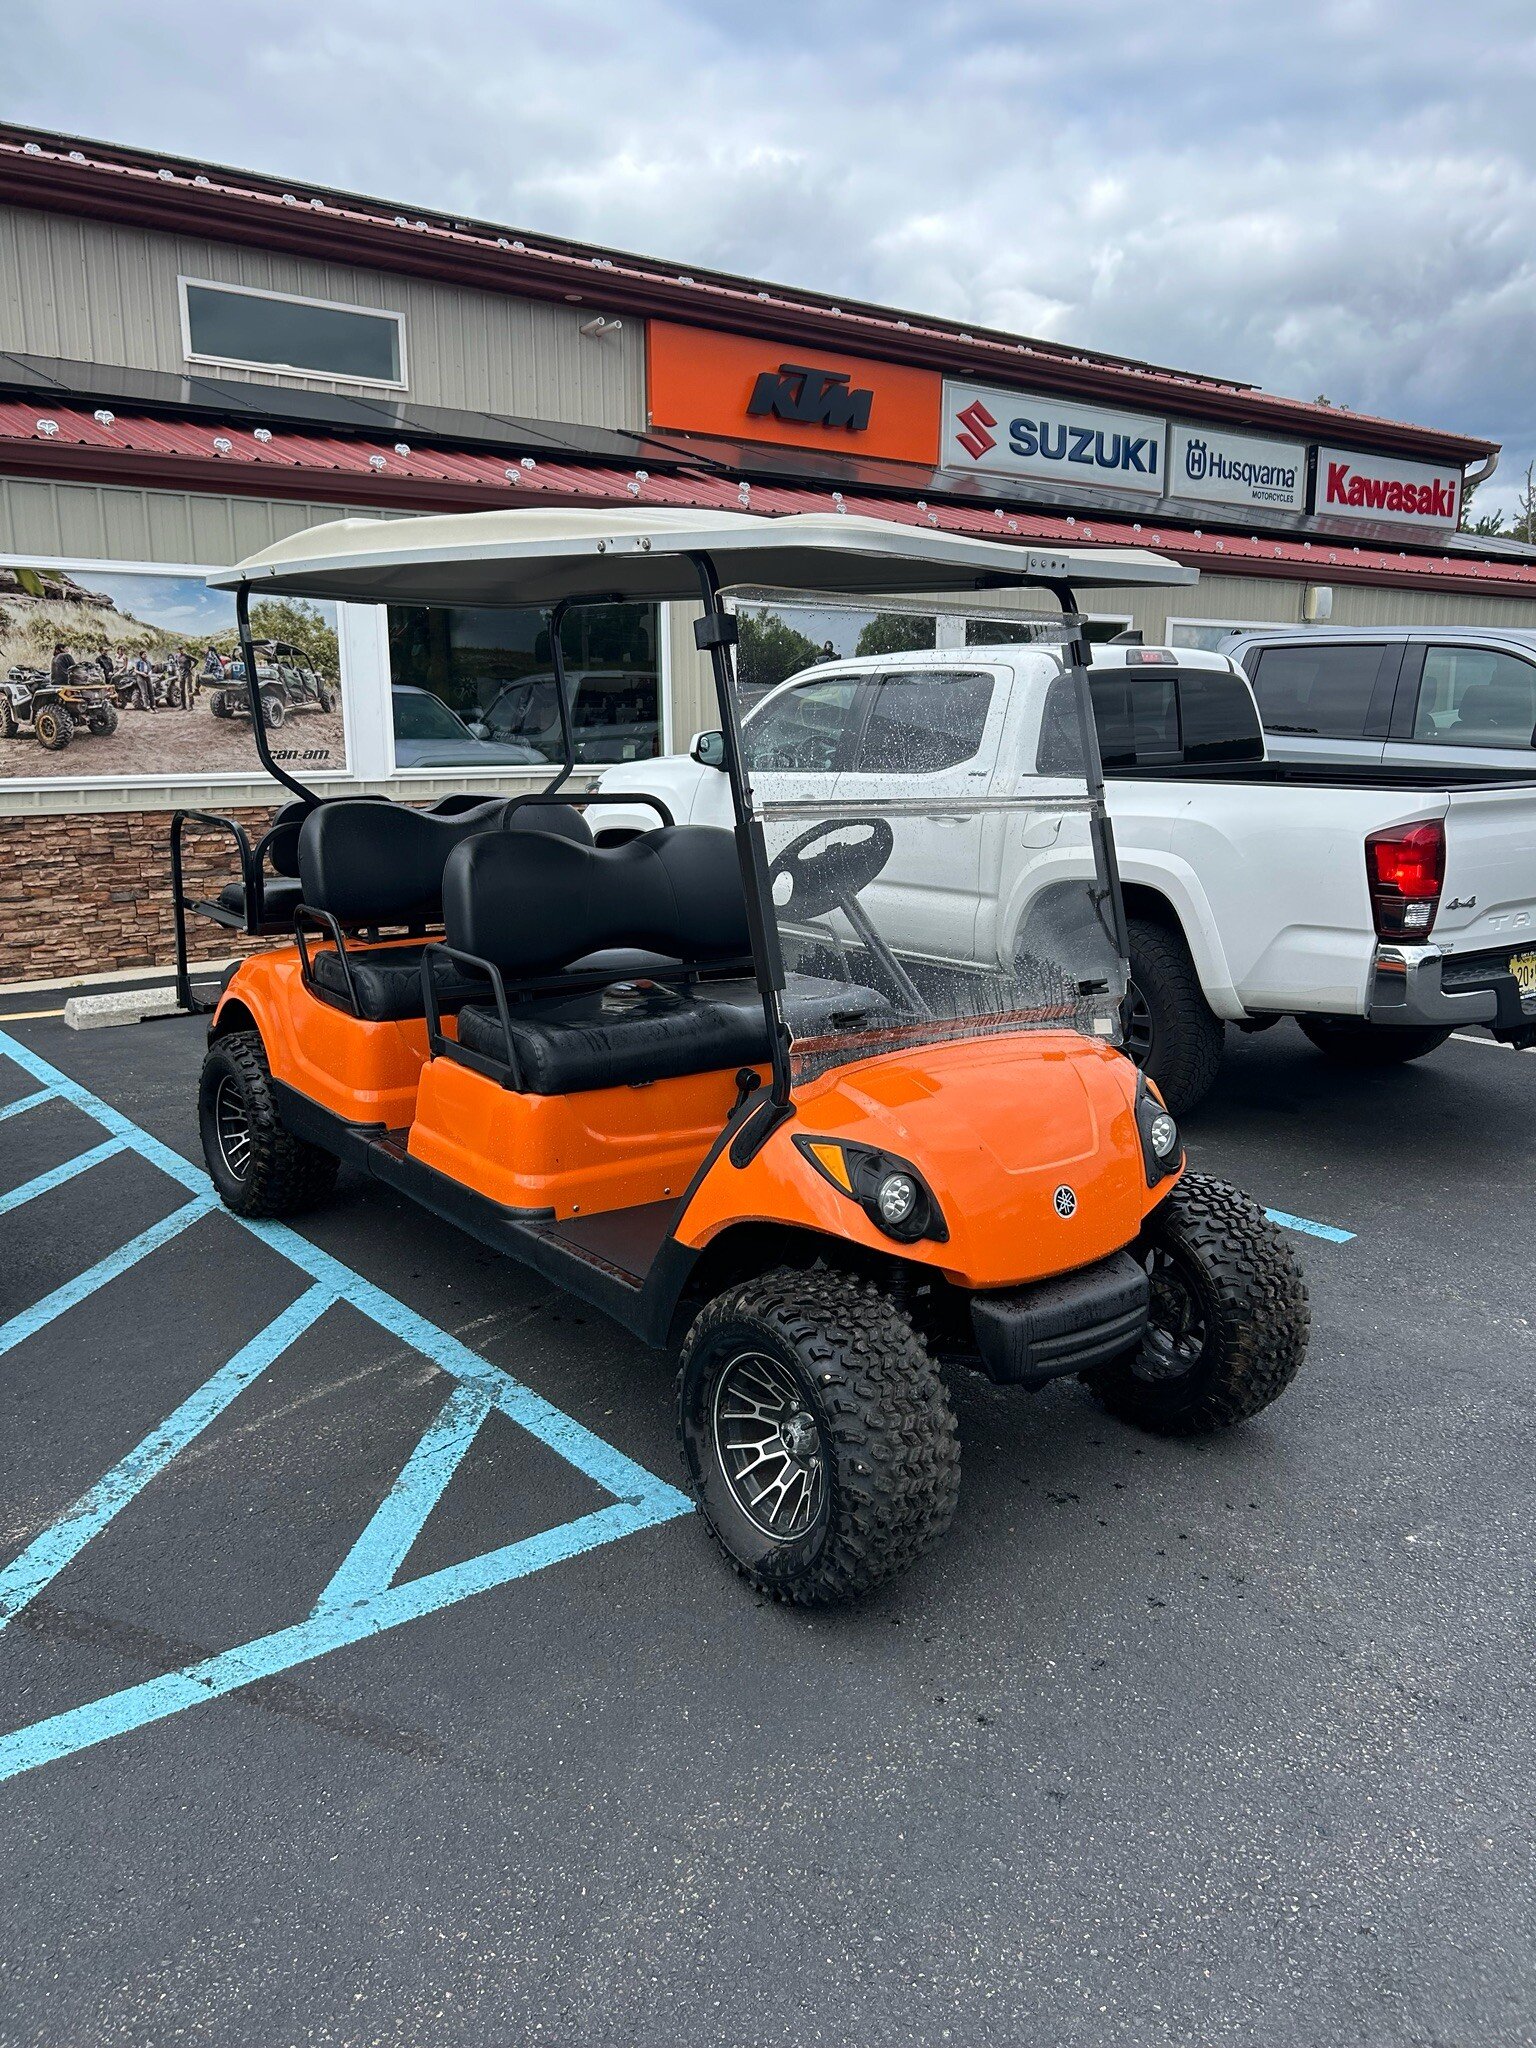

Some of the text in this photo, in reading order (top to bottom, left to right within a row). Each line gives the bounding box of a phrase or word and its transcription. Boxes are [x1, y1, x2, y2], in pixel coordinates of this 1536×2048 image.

[746, 363, 874, 431] KTM
[1009, 418, 1158, 474] SUZUKI
[1209, 452, 1295, 487] Husqvarna
[1327, 462, 1456, 518] Kawasaki
[1252, 490, 1294, 503] MOTORCYCLES
[269, 749, 331, 760] can-am
